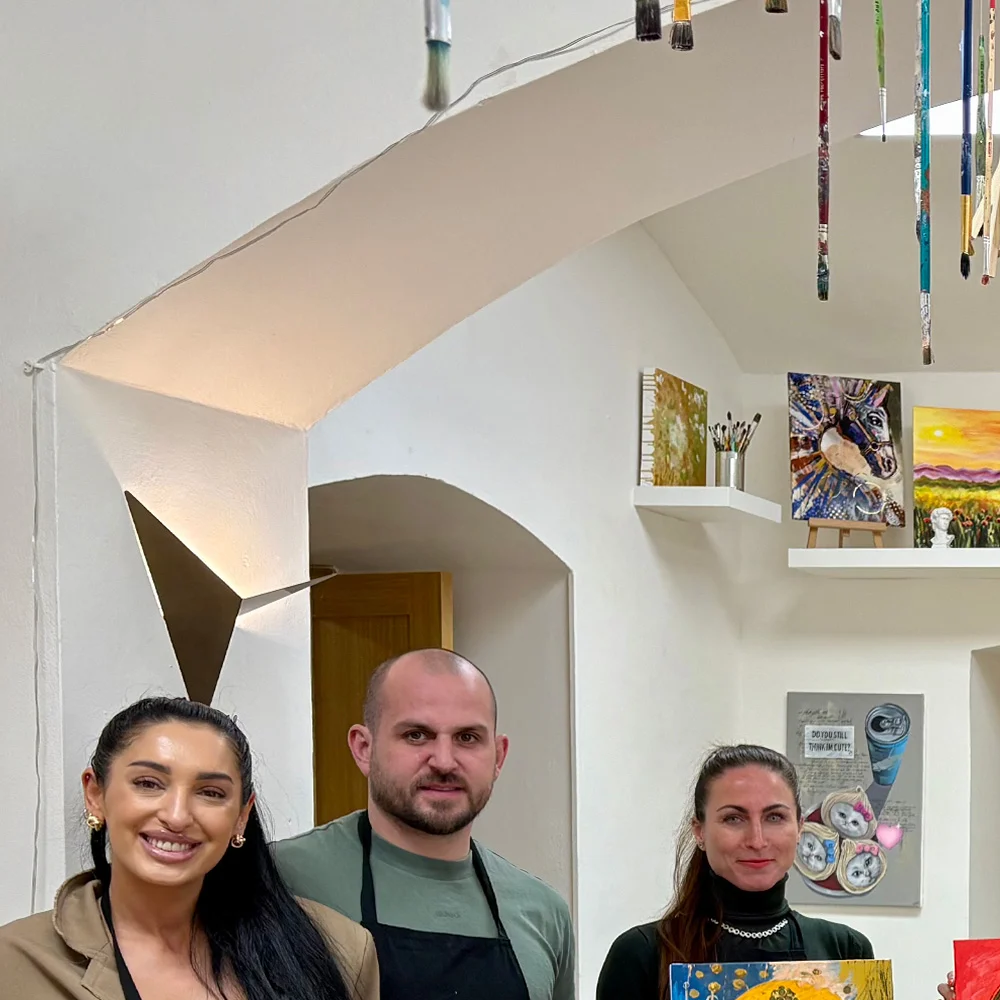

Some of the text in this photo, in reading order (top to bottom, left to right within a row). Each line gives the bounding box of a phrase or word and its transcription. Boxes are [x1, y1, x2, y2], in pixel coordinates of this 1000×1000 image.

[811, 730, 848, 739] DO YOU STILL
[809, 743, 826, 751] THINK
